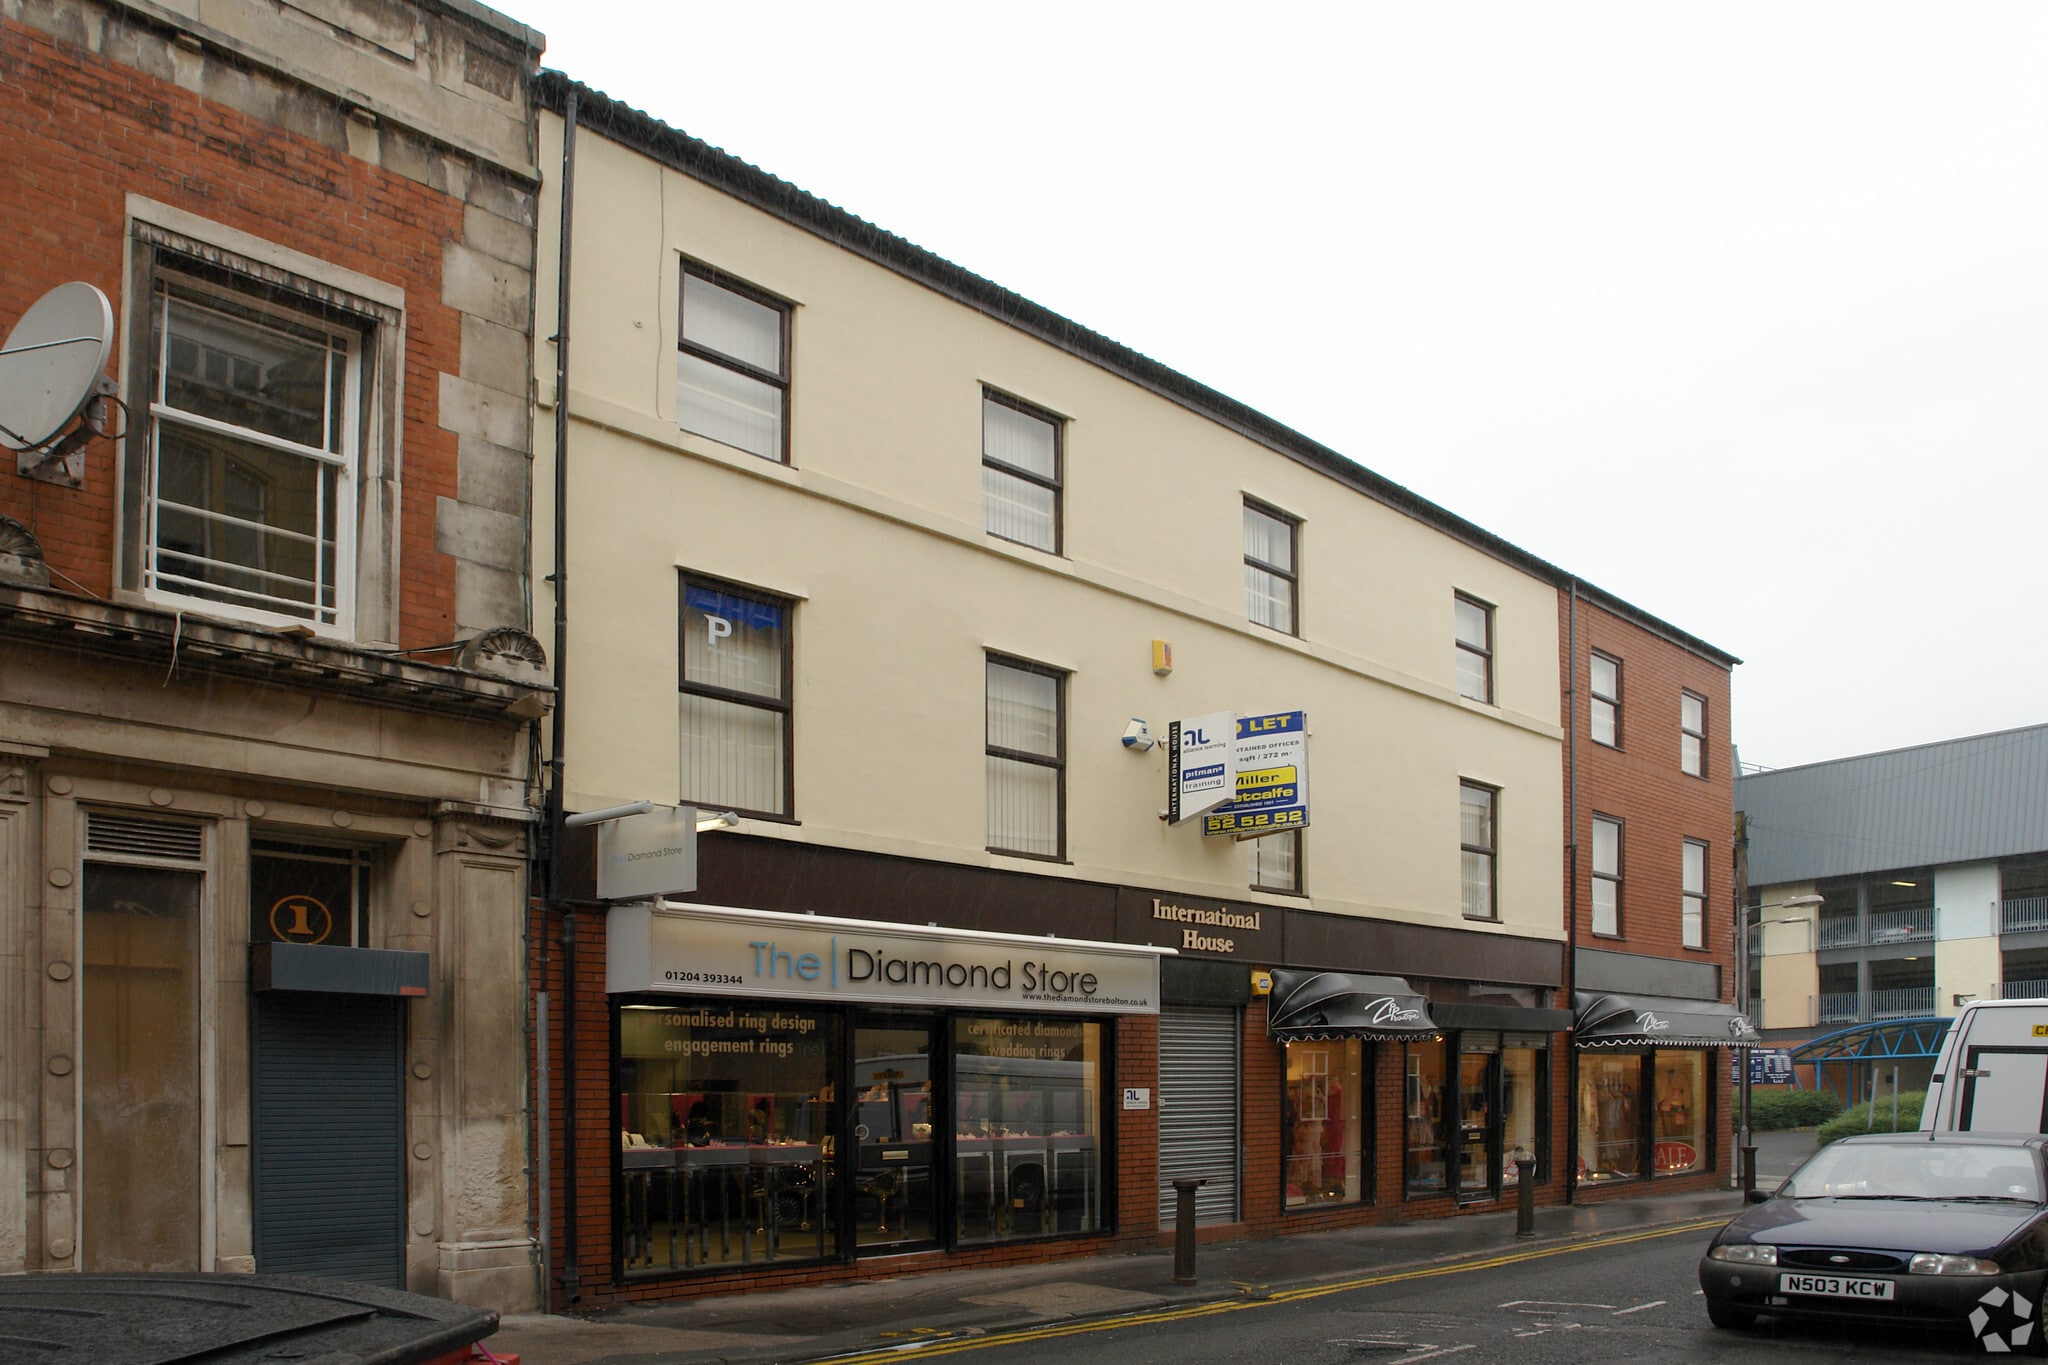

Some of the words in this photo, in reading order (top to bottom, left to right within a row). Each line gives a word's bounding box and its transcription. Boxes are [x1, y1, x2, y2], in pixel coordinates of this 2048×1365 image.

[1250, 715, 1291, 732] LET
[1183, 746, 1203, 754] alliance
[1204, 742, 1226, 750] learning
[1269, 740, 1300, 749] OFFICES
[1185, 779, 1222, 790] training
[1233, 786, 1294, 803] etcalfe
[1208, 819, 1235, 830] 52
[1241, 814, 1269, 826] 52
[1274, 810, 1303, 822] 52
[627, 848, 662, 862] Diamond
[664, 846, 682, 857] Store
[1152, 898, 1261, 931] International
[1182, 929, 1234, 953] House
[750, 941, 821, 980] The
[848, 948, 1011, 990] Diamond
[1022, 961, 1098, 994] Store
[665, 970, 700, 983] 01204
[703, 973, 744, 985] 393344
[1022, 992, 1148, 1006] www.thediamondstorebolton.co.uk
[640, 1009, 734, 1028] rsonalised
[738, 1013, 767, 1033] ring
[771, 1013, 816, 1034] design
[1034, 1022, 1083, 1038] diamonds
[664, 1039, 755, 1057] engagement
[759, 1038, 794, 1058] rings
[989, 1042, 1035, 1059] wedding
[1039, 1044, 1066, 1061] rings
[1654, 1147, 1687, 1165] ALE
[1788, 1277, 1840, 1294] N503
[1845, 1280, 1887, 1297] KCW
